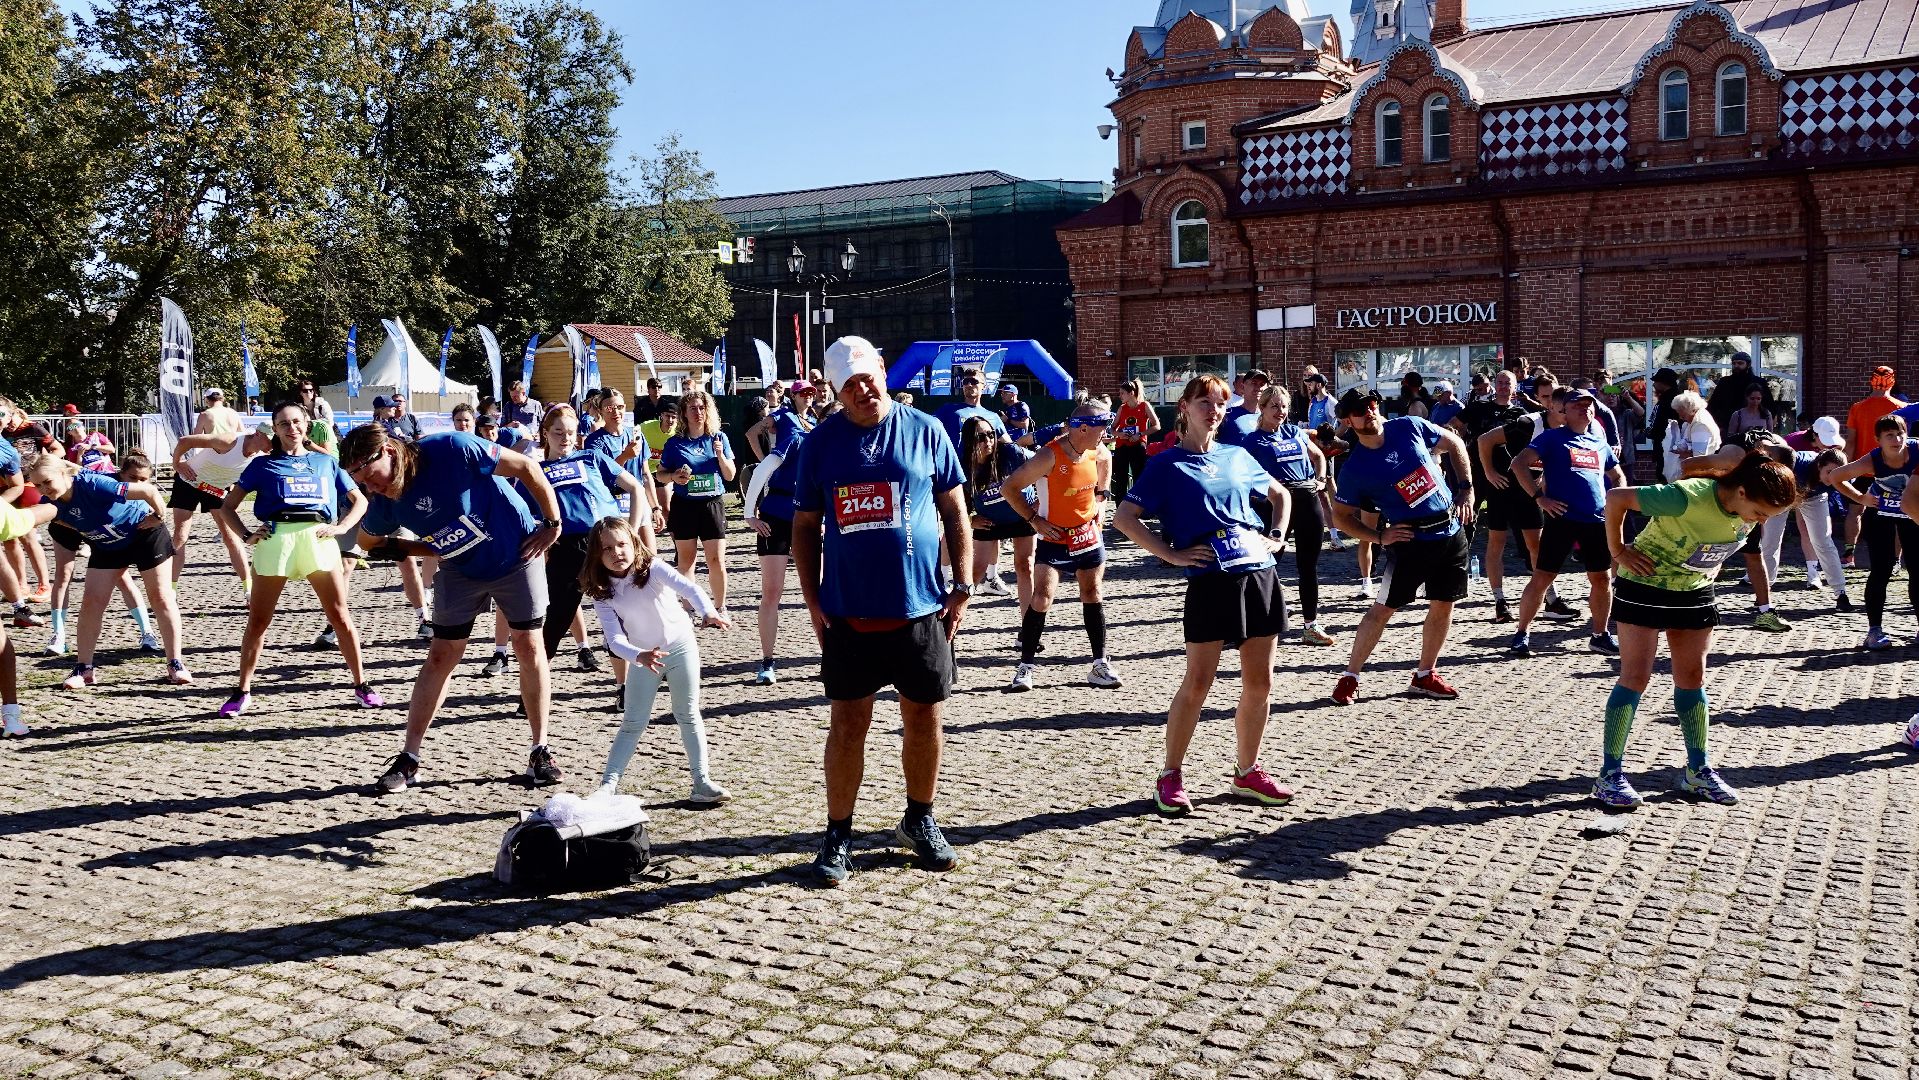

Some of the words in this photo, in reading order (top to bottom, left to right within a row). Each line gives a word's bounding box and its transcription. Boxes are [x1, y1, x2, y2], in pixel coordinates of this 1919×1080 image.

[1335, 301, 1497, 329] ГАСТРОНОМ
[1277, 443, 1298, 452] 1285
[547, 466, 576, 479] 1325
[289, 483, 318, 493] 1337
[693, 480, 711, 489] 5116
[1405, 475, 1429, 496] 2141
[842, 495, 886, 515] 2148
[1883, 499, 1901, 508] 123
[431, 528, 467, 550] 1409
[1700, 551, 1728, 562] 1251
